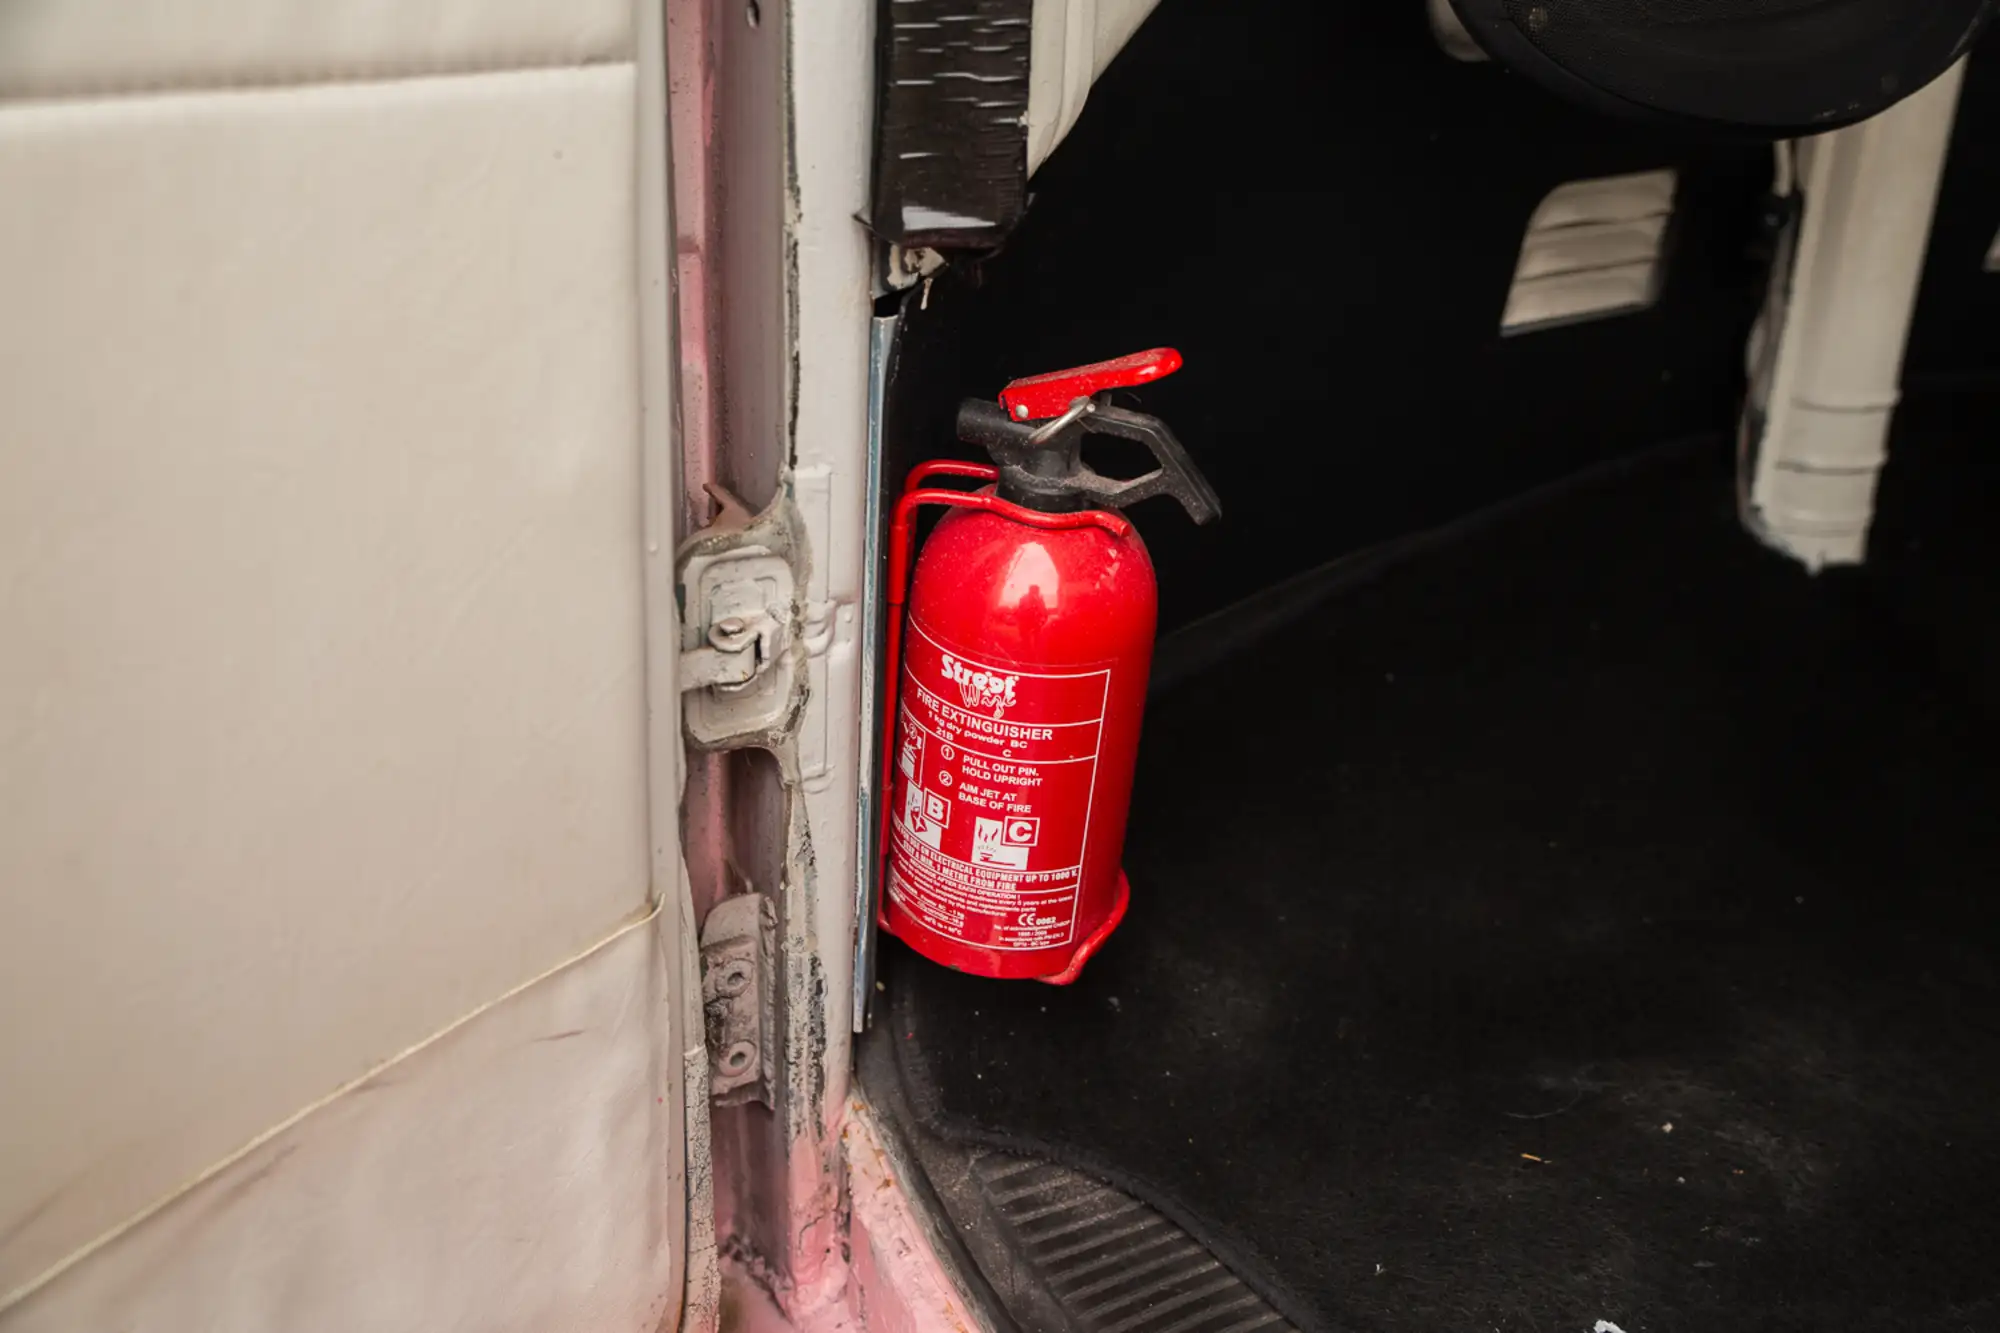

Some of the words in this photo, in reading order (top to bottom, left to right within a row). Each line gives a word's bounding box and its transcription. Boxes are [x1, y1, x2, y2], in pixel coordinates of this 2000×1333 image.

[917, 687, 940, 713] FIRE
[941, 704, 1053, 741] EXTINGUISHER
[946, 721, 962, 735] dry
[963, 730, 1005, 746] powder
[1010, 739, 1028, 749] BC
[1001, 749, 1013, 758] C
[962, 765, 991, 780] HOLD
[993, 774, 1043, 787] UPRIGHT
[963, 754, 990, 770] PULL
[992, 763, 1016, 774] OUT
[1018, 766, 1039, 777] PIN.
[958, 791, 987, 807] BASE
[988, 801, 1004, 810] OF
[1006, 803, 1032, 814] FIRE
[959, 782, 979, 795] AIM
[980, 788, 1000, 800] JET
[1002, 792, 1017, 802] AT
[927, 795, 944, 820] B
[1008, 821, 1032, 842] C
[930, 852, 973, 875] ELECTRICAL
[975, 868, 1024, 883] EQUIPMENT
[1025, 875, 1037, 883] UP
[1039, 874, 1049, 882] TO
[942, 867, 969, 884] METRE
[970, 877, 995, 888] FROM
[996, 881, 1017, 891] FIRE
